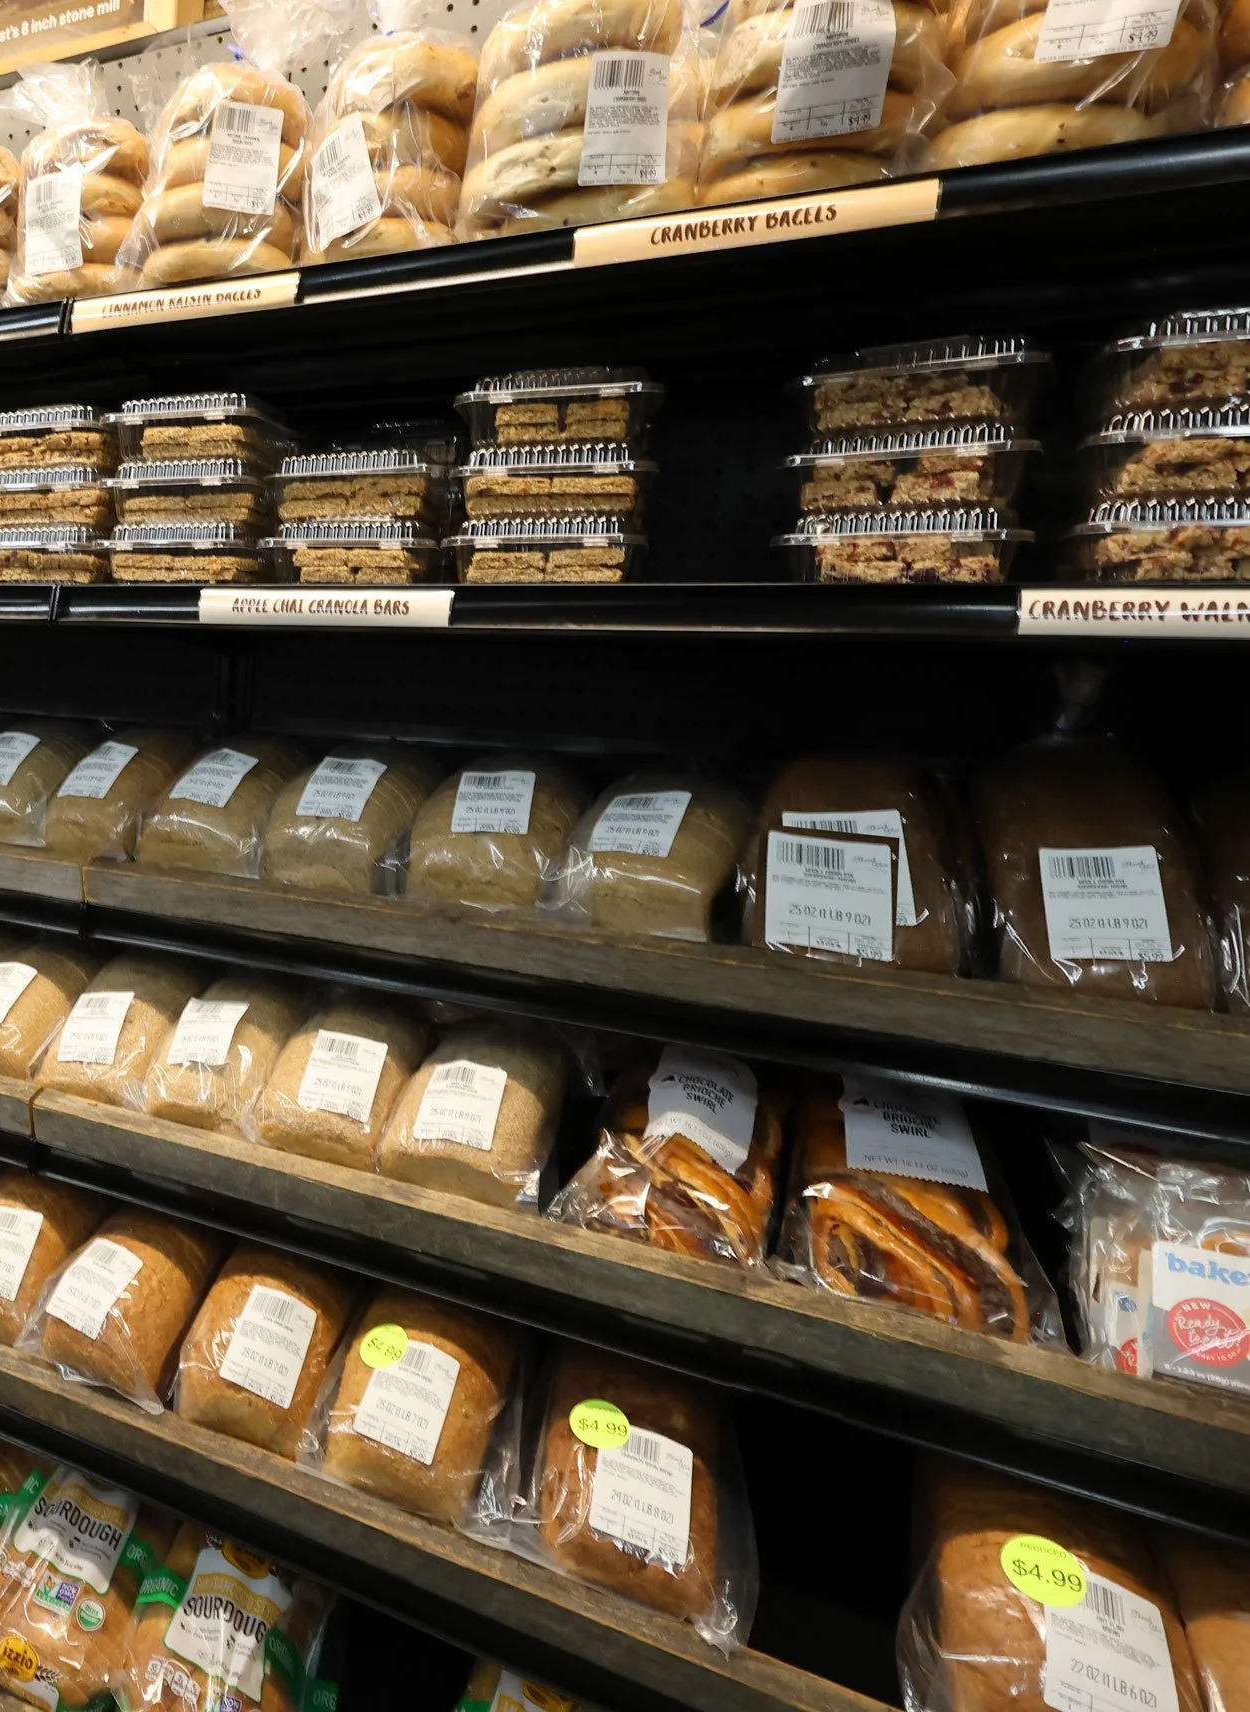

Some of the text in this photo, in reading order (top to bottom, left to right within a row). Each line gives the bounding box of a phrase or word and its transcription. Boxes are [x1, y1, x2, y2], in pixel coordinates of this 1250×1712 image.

[21, 20, 30, 36] 8
[31, 14, 58, 33] inch
[59, 8, 95, 27] stone
[97, 0, 121, 16] mill
[650, 203, 838, 246] CRANBERRY BAGELS
[231, 597, 411, 616] APPLE CHAI GRANOLA BARS
[1028, 600, 1172, 622] CRANBERRY
[789, 903, 802, 916] 25
[804, 904, 817, 919] OZ
[829, 908, 844, 922] LB
[845, 912, 853, 923] 9
[1068, 917, 1082, 930] 25
[1083, 918, 1096, 930] OZ
[1108, 917, 1121, 930] LB
[1123, 918, 1130, 930] 9
[676, 1073, 736, 1106] CHOCOLATE
[682, 1083, 727, 1109] BRIOCHE
[685, 1092, 718, 1115] SWIRL
[882, 1111, 936, 1131] BRIOCHE
[890, 1122, 933, 1139] SWIRL
[864, 1153, 882, 1163] NET
[883, 1155, 898, 1165] WT
[1165, 1252, 1250, 1288] bake
[1181, 1301, 1212, 1312] NEW
[1176, 1314, 1221, 1337] Ready
[577, 1417, 628, 1438] $4.99
[34, 1497, 123, 1551] SOURDOUGH
[1018, 1541, 1068, 1560] REDUCED
[139, 1576, 179, 1597] ORGANIC
[1011, 1557, 1084, 1594] $4.99
[59, 1589, 76, 1600] GMO
[62, 1582, 79, 1595] NON
[184, 1594, 270, 1645] SOURDOUG
[2, 1646, 34, 1671] izzio
[1069, 1657, 1085, 1674] 22
[1086, 1664, 1101, 1684] OZ
[1113, 1676, 1129, 1697] LB
[1130, 1683, 1138, 1701] 6
